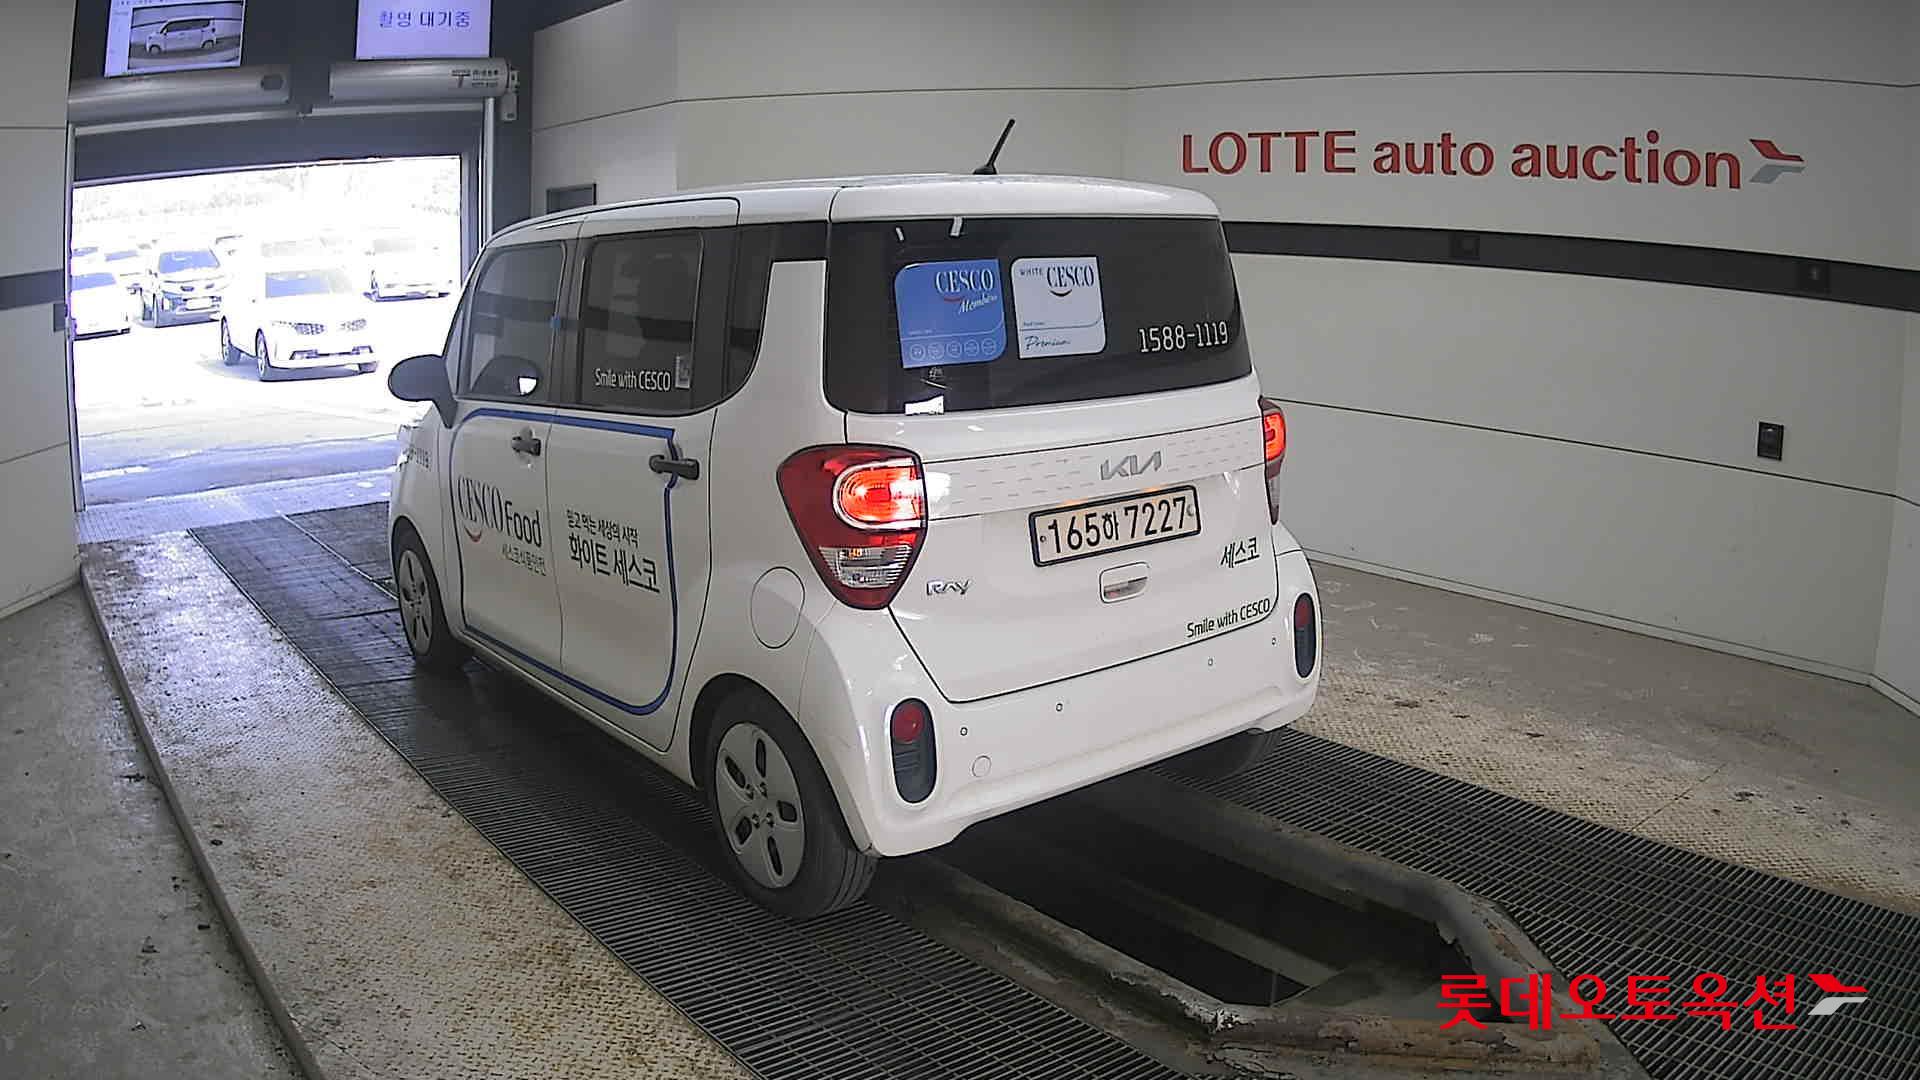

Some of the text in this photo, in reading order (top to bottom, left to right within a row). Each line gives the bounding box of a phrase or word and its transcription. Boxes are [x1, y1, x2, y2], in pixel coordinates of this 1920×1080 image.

[420, 10, 471, 28] 대기중
[1182, 129, 1741, 190] LOTTE auto auction
[935, 268, 994, 293] CESCO
[1047, 265, 1094, 288] CESCO
[1138, 320, 1229, 353] 1588-1119
[595, 367, 671, 391] Smile with CESCO
[457, 475, 543, 548] CESCO Food
[622, 526, 639, 549] 시작
[1220, 536, 1260, 568] 세스코
[569, 532, 661, 593] 화이트 세스코
[1186, 597, 1271, 638] Smile with CESCO
